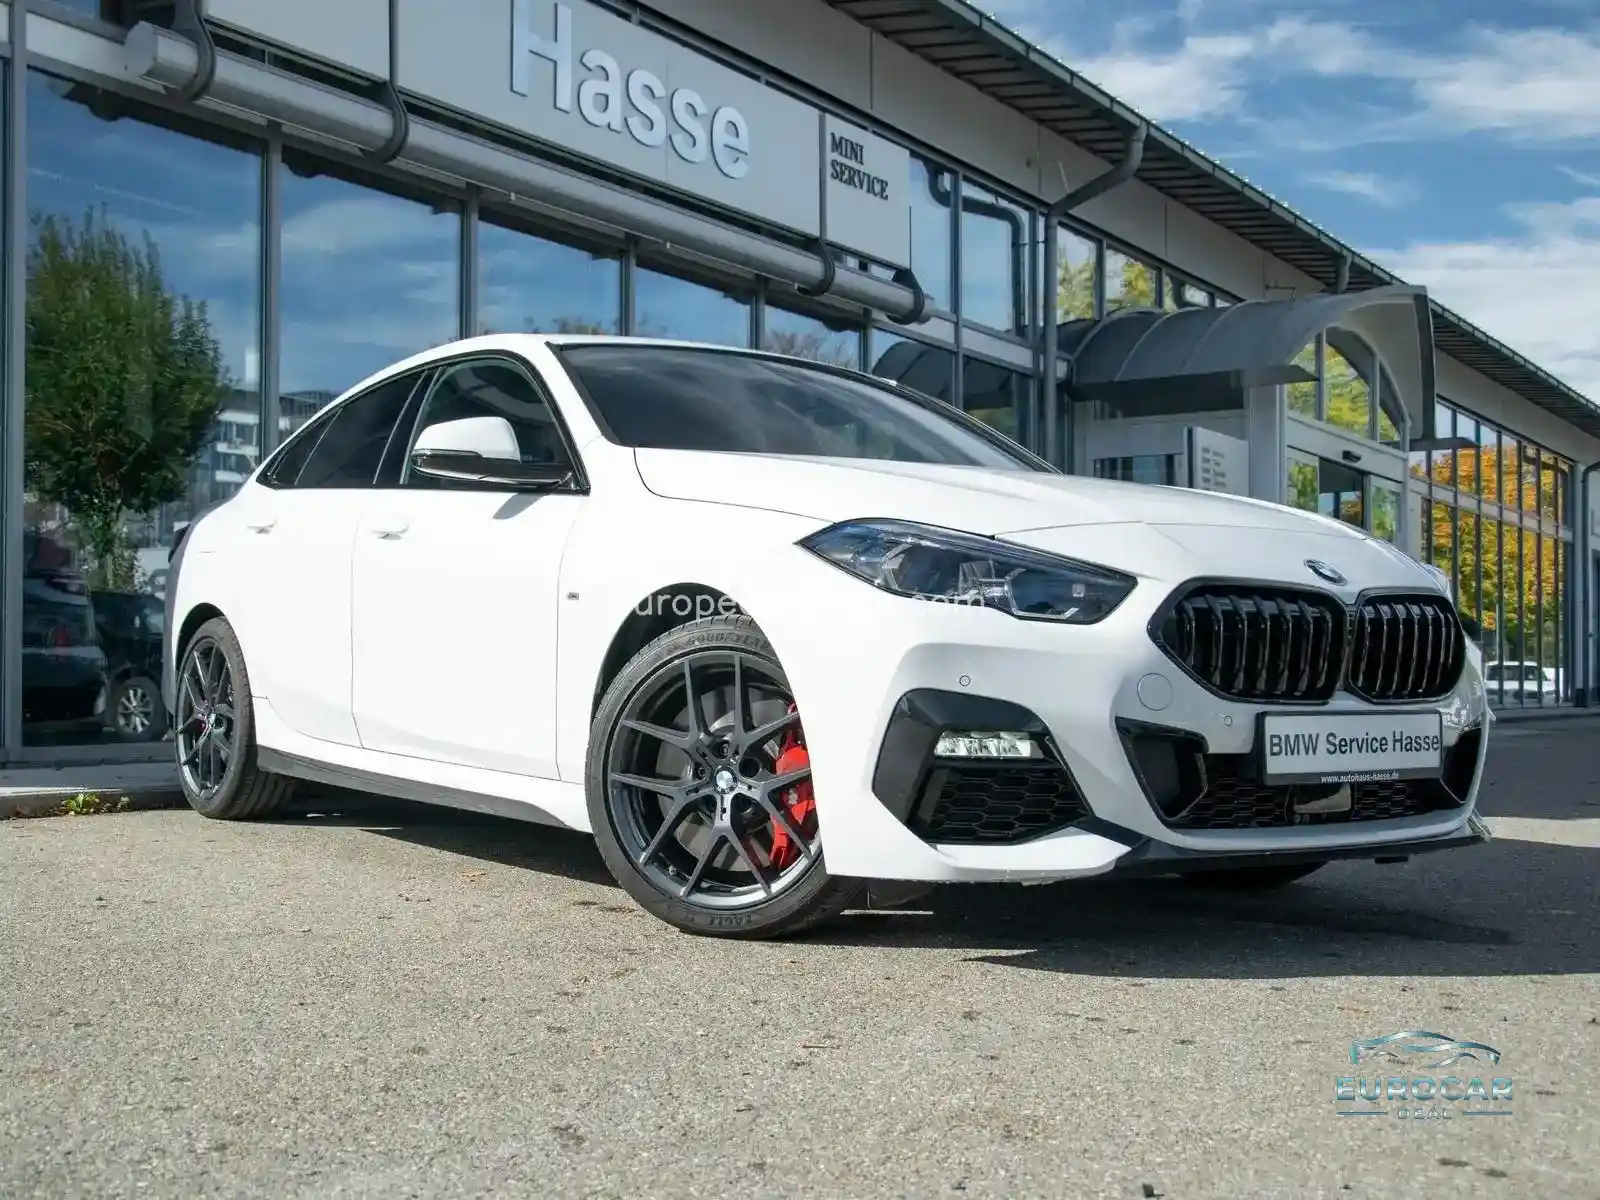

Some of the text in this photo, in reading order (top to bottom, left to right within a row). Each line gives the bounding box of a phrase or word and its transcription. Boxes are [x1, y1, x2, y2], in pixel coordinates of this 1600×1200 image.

[510, 0, 750, 179] Hasse
[830, 131, 865, 166] MINI
[830, 158, 889, 200] SERVICE
[1269, 730, 1440, 757] BMW Service Hasse
[1320, 770, 1399, 783] www.autohaus-hasse.de
